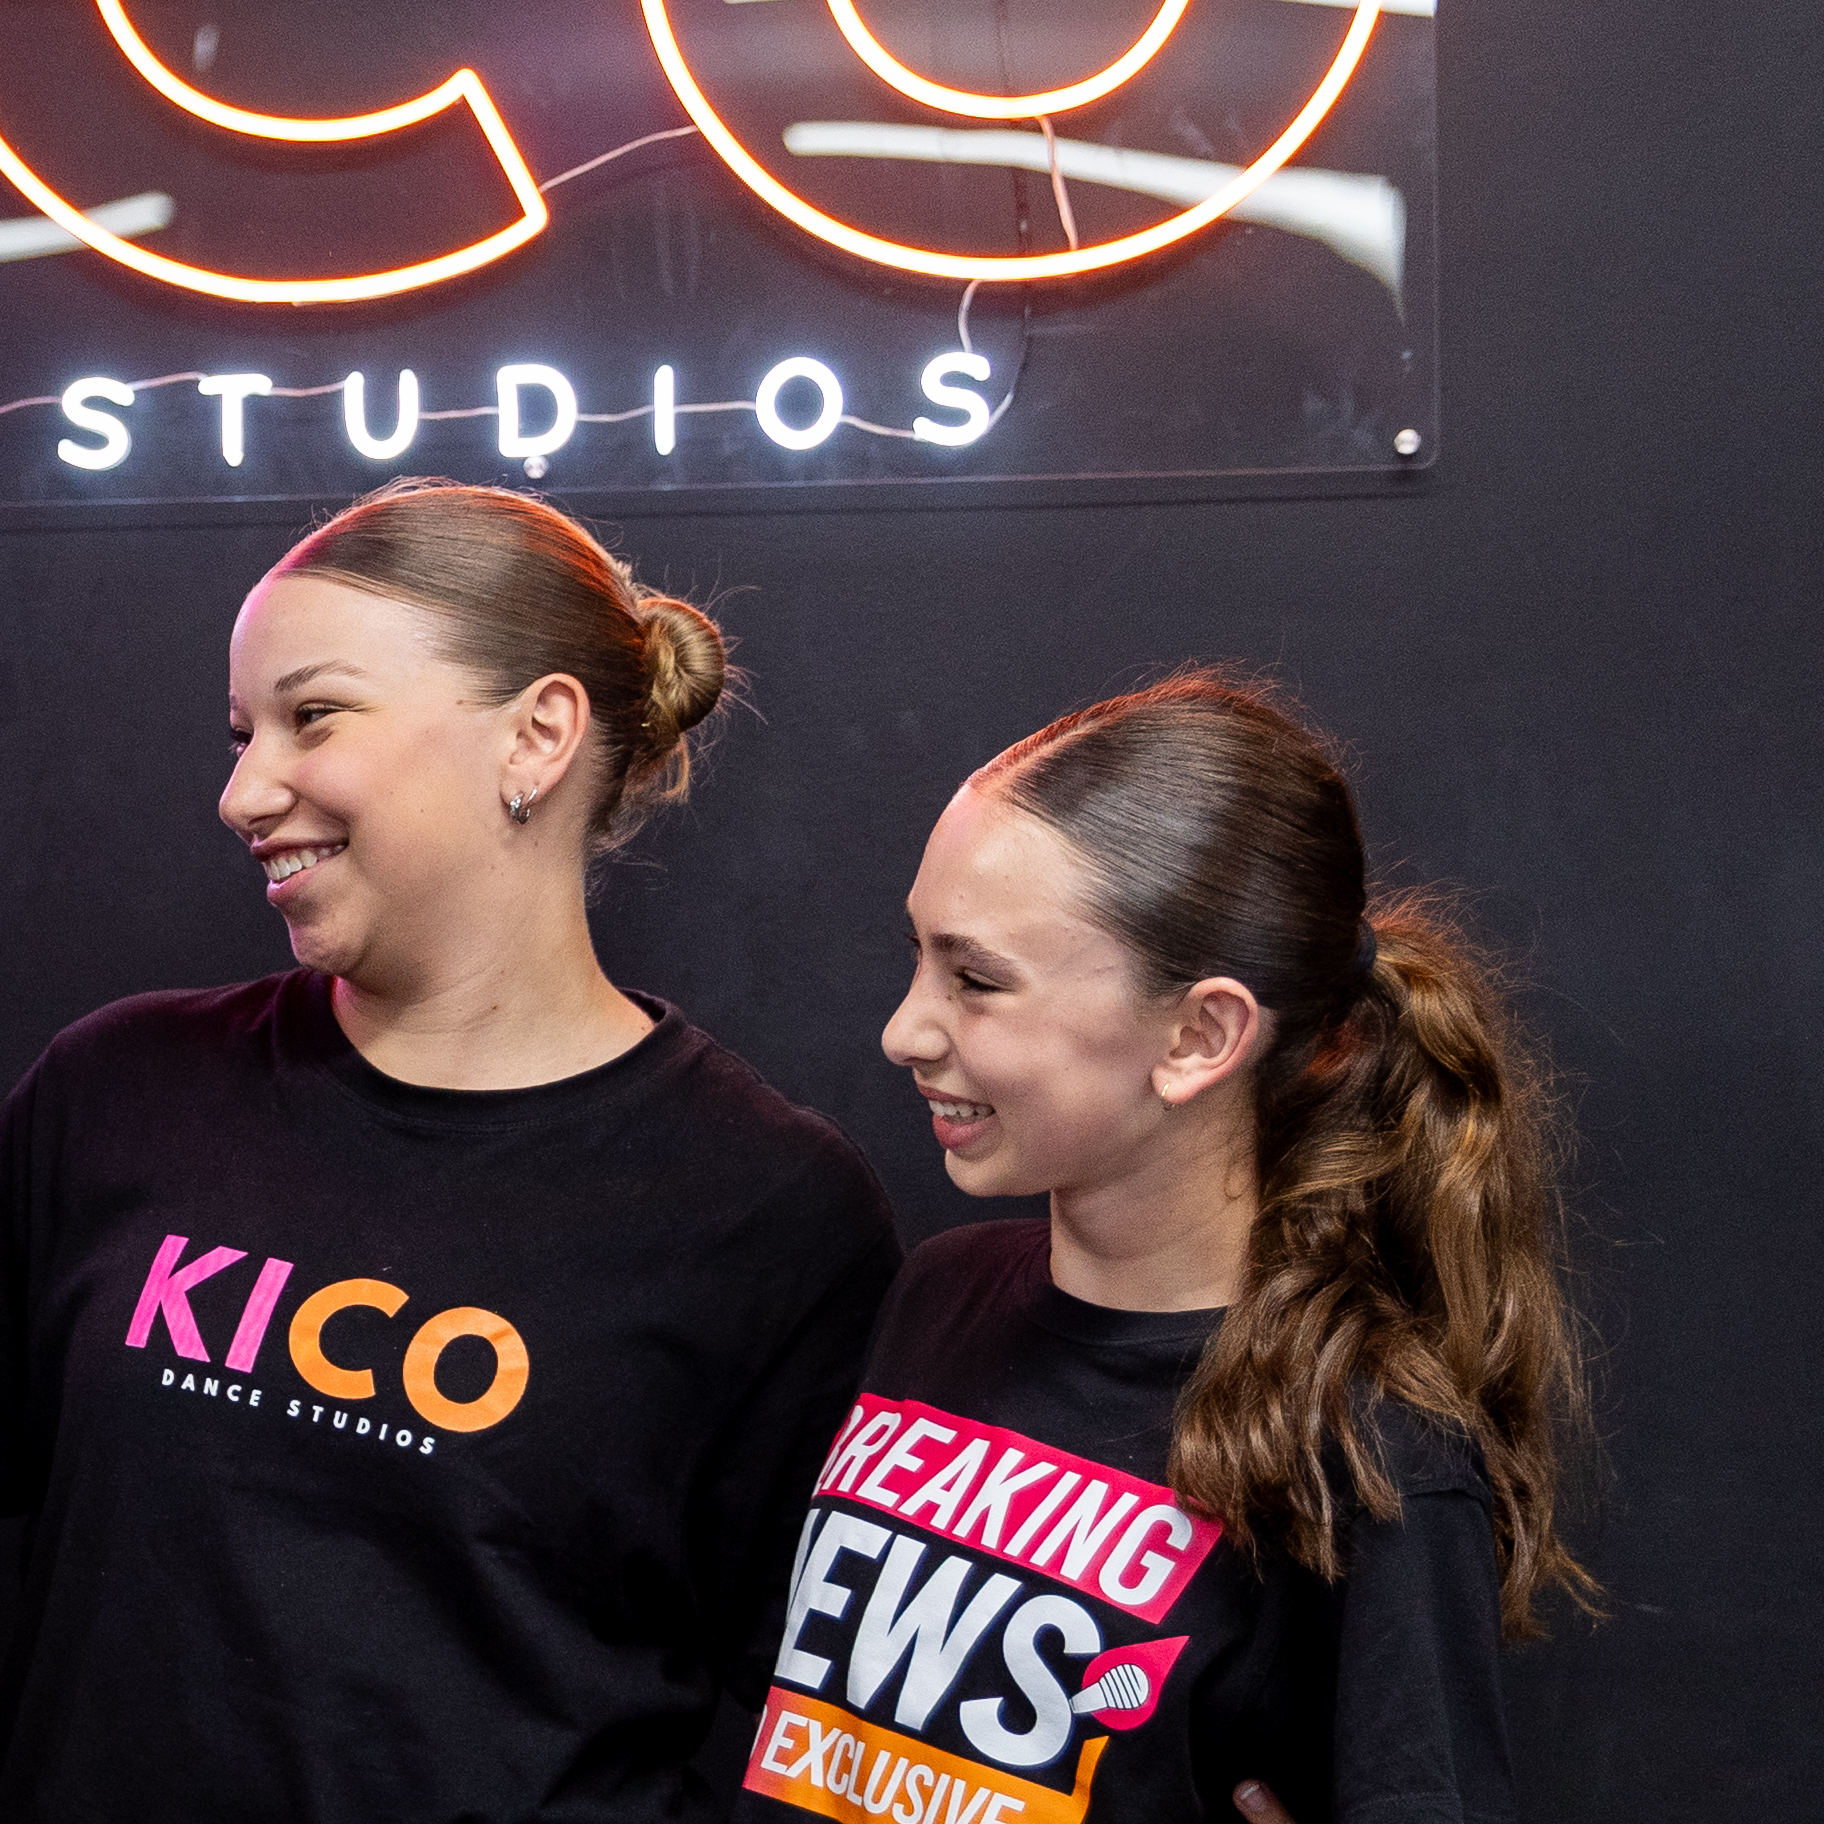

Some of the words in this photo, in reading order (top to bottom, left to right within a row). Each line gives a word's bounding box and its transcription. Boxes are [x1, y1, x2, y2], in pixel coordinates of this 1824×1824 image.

[57, 350, 992, 470] STUDIOS
[124, 1233, 530, 1433] KICO
[161, 1367, 263, 1407] DANCE
[286, 1399, 436, 1455] STUDIOS
